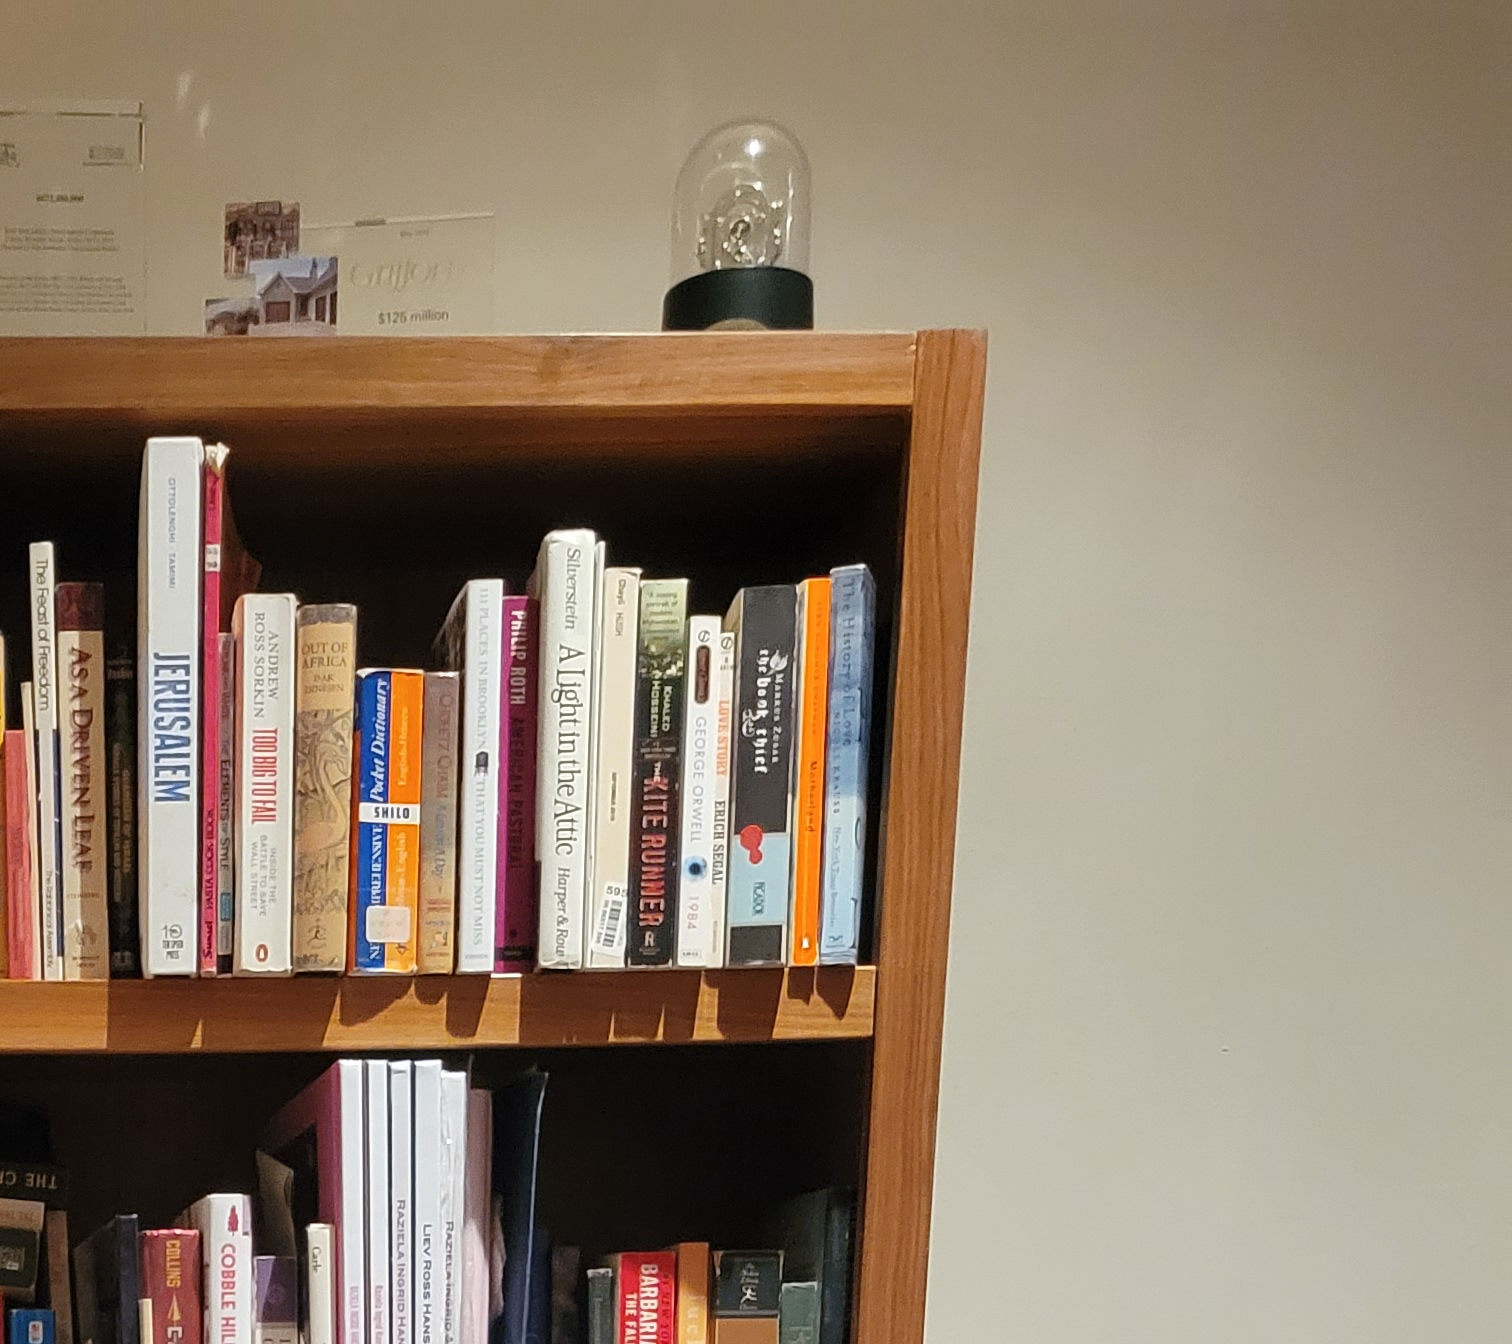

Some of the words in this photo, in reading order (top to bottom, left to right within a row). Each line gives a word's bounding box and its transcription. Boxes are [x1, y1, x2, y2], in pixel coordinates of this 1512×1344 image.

[410, 309, 449, 322] million
[36, 559, 49, 589] The
[167, 552, 177, 589] TAMIMI
[564, 548, 582, 630] Silverstein
[37, 593, 51, 631] Feast
[253, 612, 266, 650] ROSS
[38, 634, 51, 646] of
[557, 644, 580, 662] A
[38, 648, 52, 711] Freedom
[70, 648, 93, 682] AS
[266, 630, 280, 700] ANDREW
[71, 684, 90, 700] A
[253, 654, 266, 718] SORKIN
[552, 668, 584, 728] Light
[153, 652, 191, 802] JERUSALEM
[649, 680, 661, 738] HOSSEINI
[661, 686, 672, 732] KHALED
[717, 700, 730, 733] LOVE
[71, 709, 96, 804] DRIVEN
[251, 728, 278, 753] TOO
[556, 732, 580, 755] in
[692, 716, 708, 777] GEORGE
[715, 735, 728, 776] STORY
[251, 756, 279, 779] BIG
[555, 759, 581, 797] the
[652, 761, 662, 782] THE
[251, 781, 279, 798] TO
[641, 778, 670, 829] KITE
[251, 800, 279, 824] FAIL
[374, 806, 410, 820] SHILO
[554, 799, 580, 855] Attic
[689, 782, 706, 843] ORWELL
[713, 800, 726, 840] ERICH
[73, 815, 97, 869] LEAF
[638, 833, 666, 927] RUNNER
[712, 844, 725, 885] SEGAL
[554, 867, 572, 913] Harper
[556, 915, 570, 928] &
[686, 895, 701, 930] 1984
[555, 930, 569, 957] Row
[421, 1224, 433, 1255] LIEV
[165, 1240, 181, 1287] COLLINS
[220, 1243, 237, 1310] COBBLE
[311, 1246, 322, 1273] Carle
[421, 1260, 433, 1300] ROSS
[624, 1293, 637, 1318] THE
